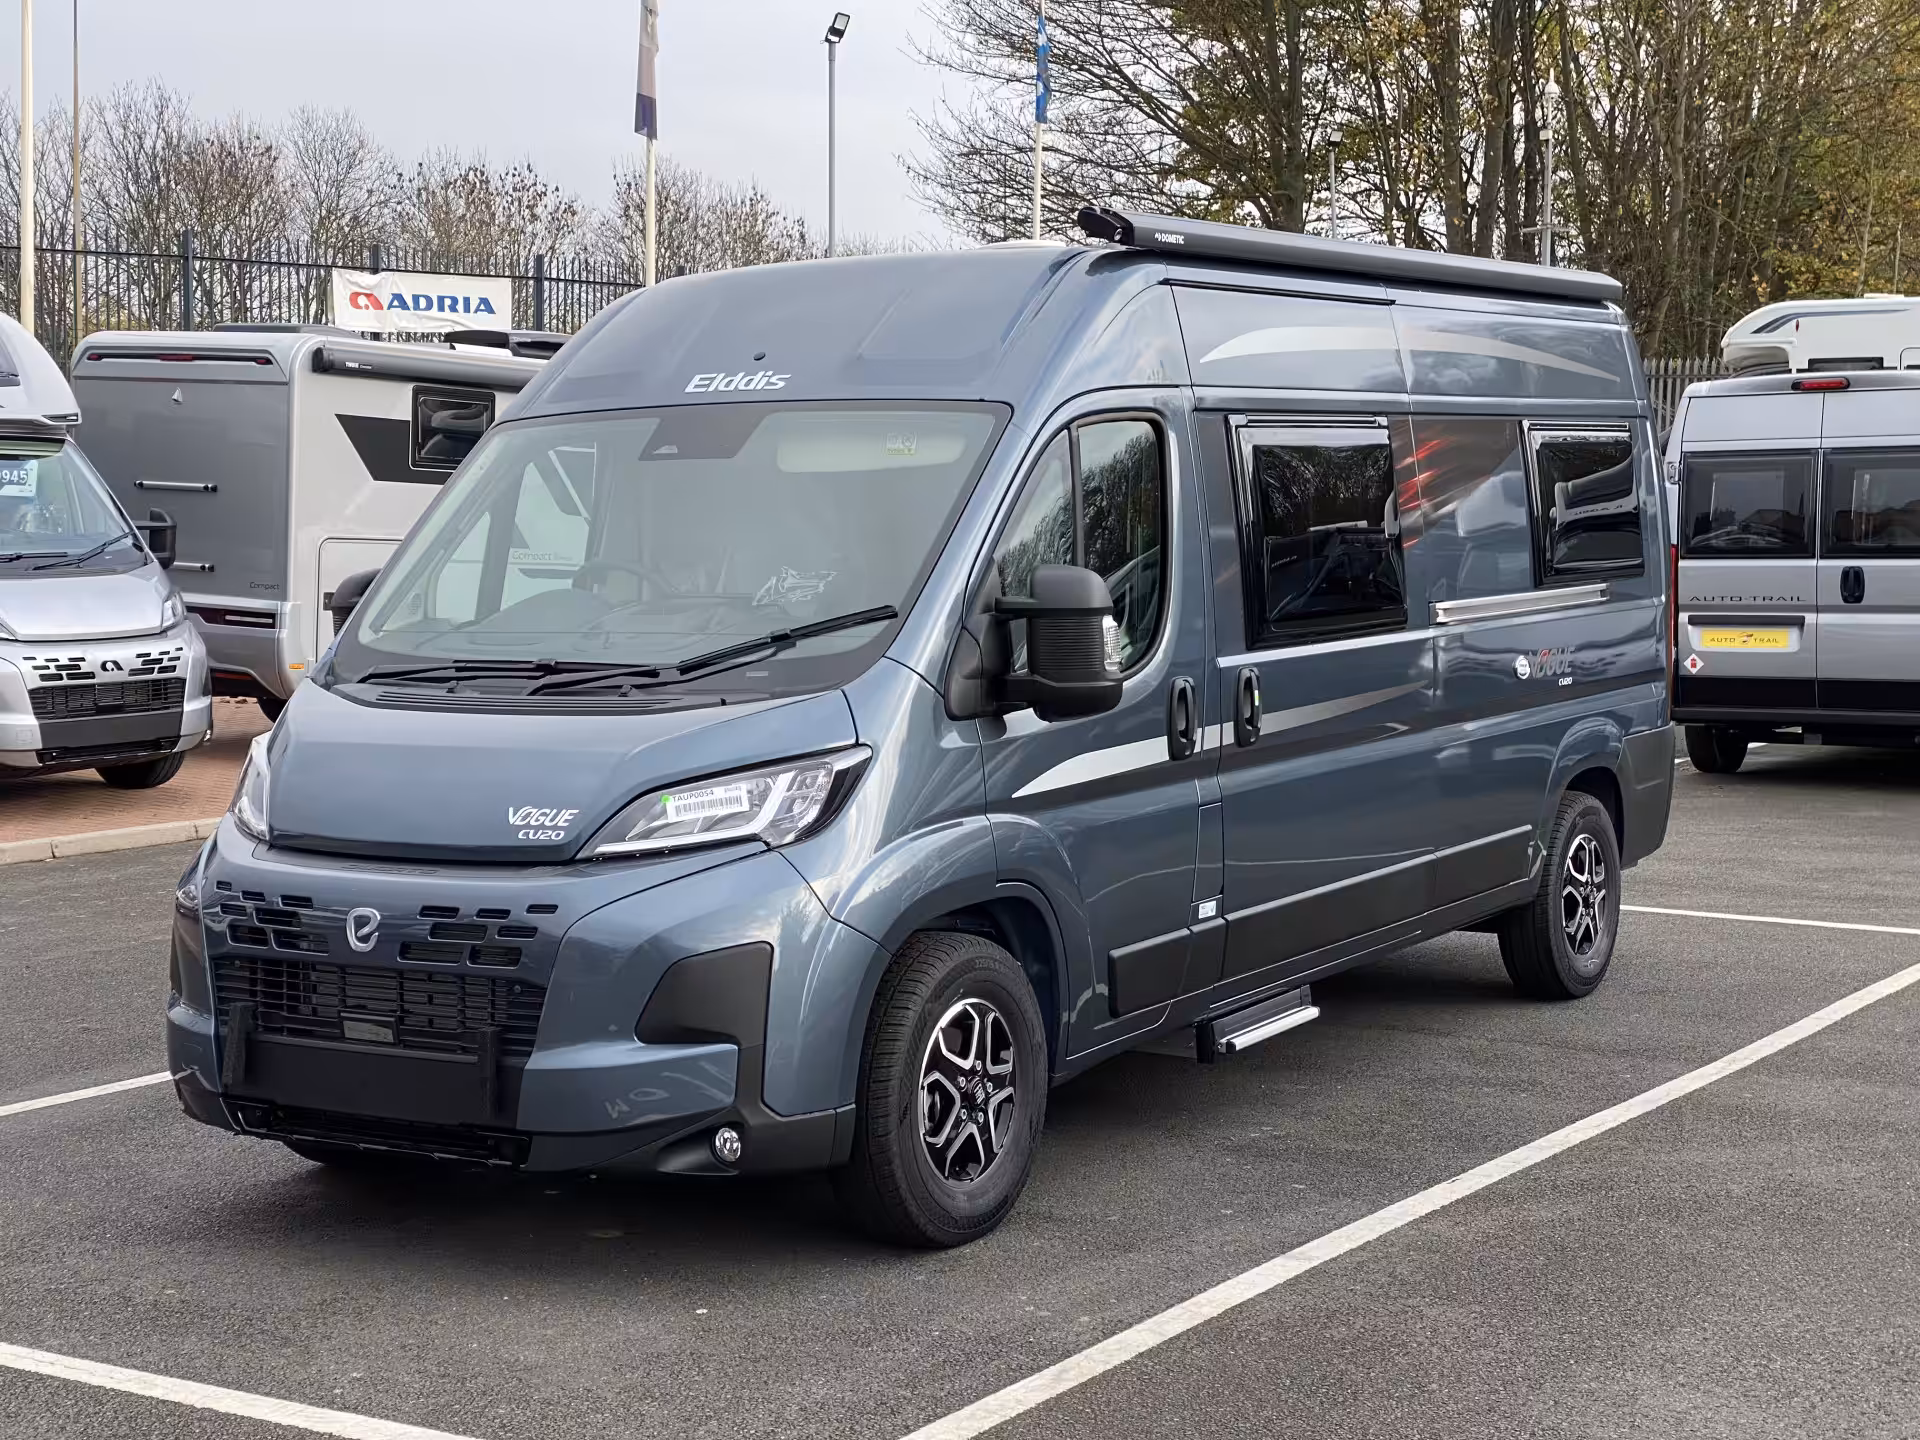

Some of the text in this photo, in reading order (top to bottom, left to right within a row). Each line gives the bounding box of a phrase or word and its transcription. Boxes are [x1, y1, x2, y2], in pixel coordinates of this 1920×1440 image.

[1161, 232, 1185, 245] DOMETIC
[386, 292, 497, 315] ADRIA
[684, 370, 792, 393] Elddis
[0, 469, 28, 484] 945
[1528, 646, 1576, 679] VOGUE
[672, 789, 714, 803] TAUP0054
[508, 806, 580, 827] VOGUE
[517, 829, 565, 841] CU20
